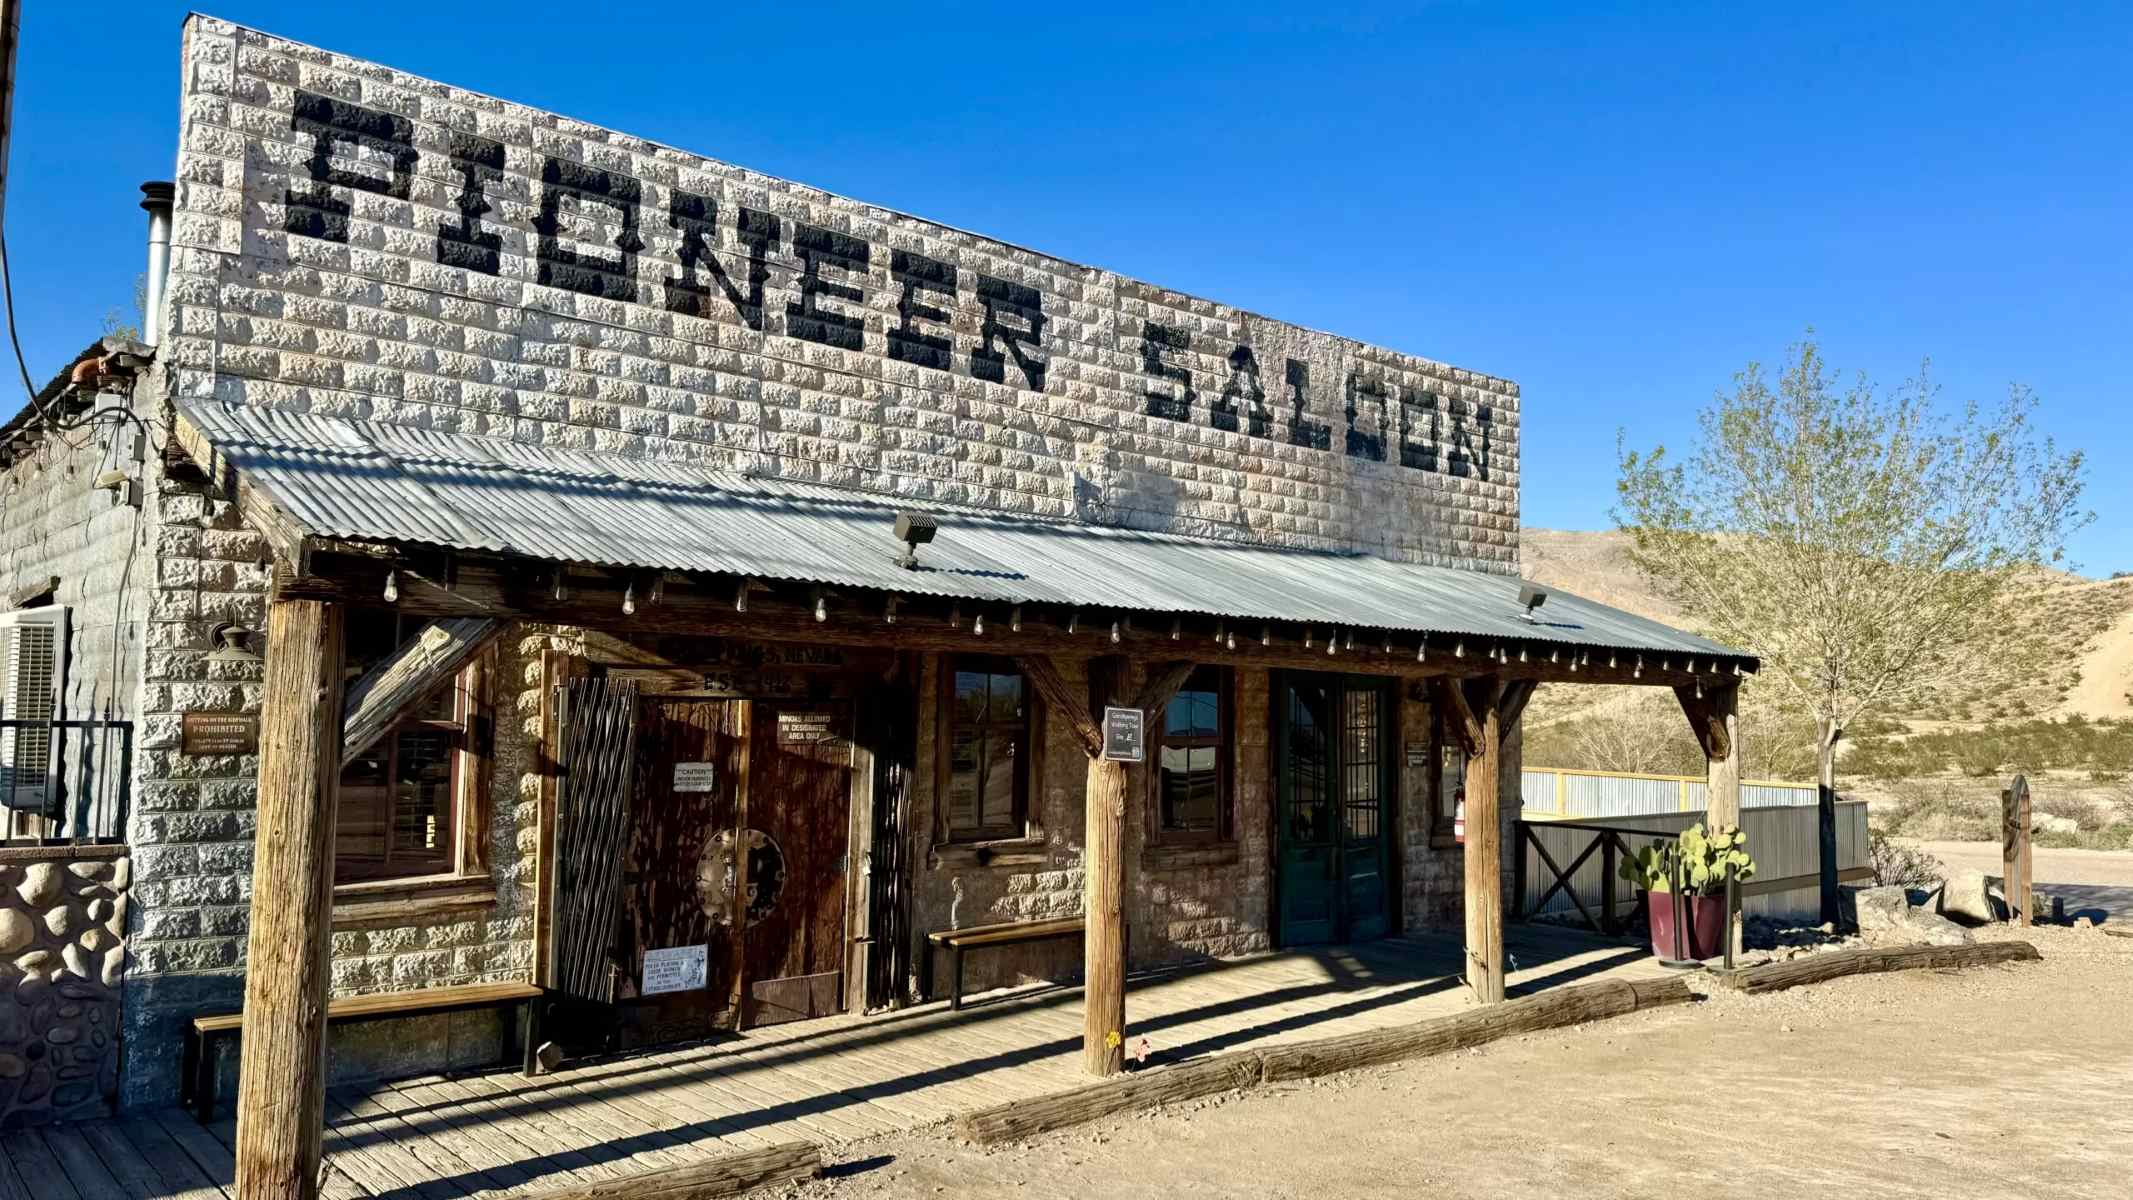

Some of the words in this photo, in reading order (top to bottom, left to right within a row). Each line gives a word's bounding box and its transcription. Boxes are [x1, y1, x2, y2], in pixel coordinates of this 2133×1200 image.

[284, 90, 1048, 392] PIONEER
[1140, 320, 1495, 482] SALOON
[193, 725, 246, 733] PROHIBITED
